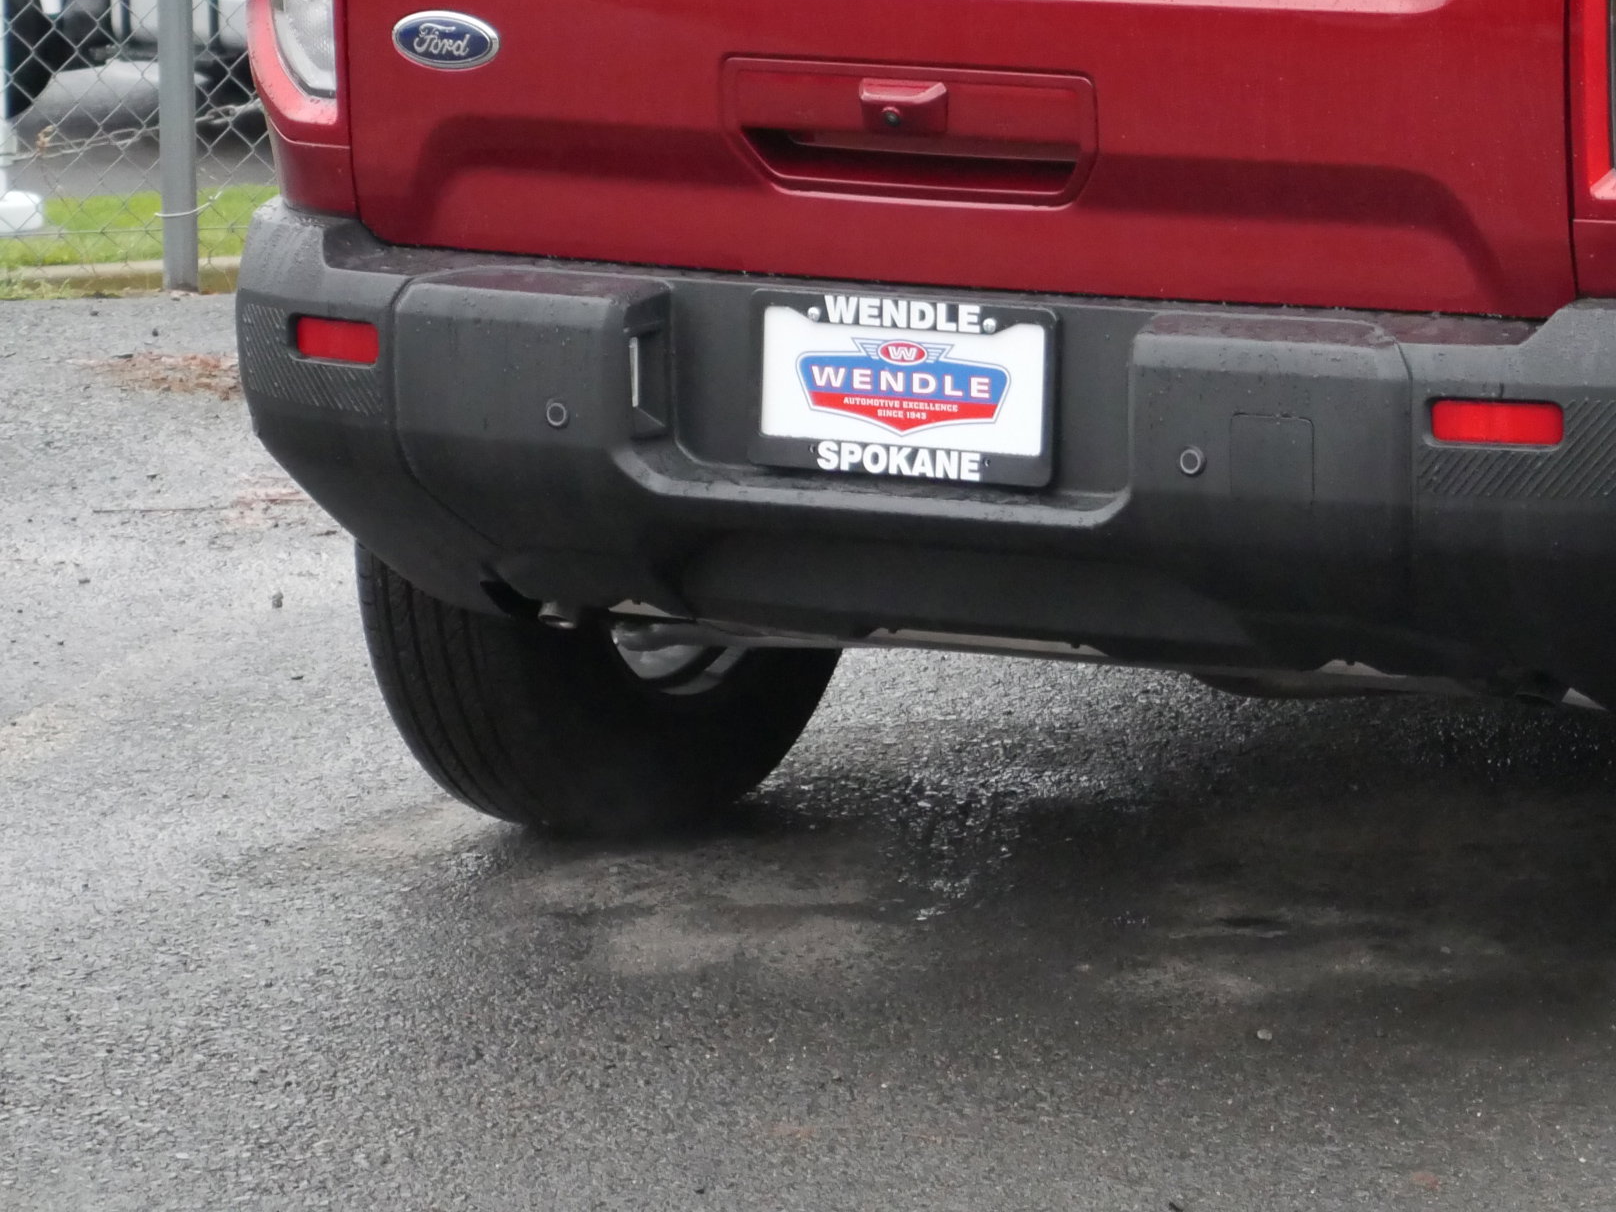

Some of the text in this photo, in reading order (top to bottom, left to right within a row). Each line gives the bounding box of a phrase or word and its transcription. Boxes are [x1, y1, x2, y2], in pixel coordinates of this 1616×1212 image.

[413, 22, 471, 56] Ford
[824, 295, 981, 333] WENDLE
[811, 365, 990, 398] WENDLE
[843, 396, 959, 412] AUTOMOTIVE EXCELLENCE
[877, 409, 904, 419] SINCE
[817, 441, 980, 481] SPOKANE
